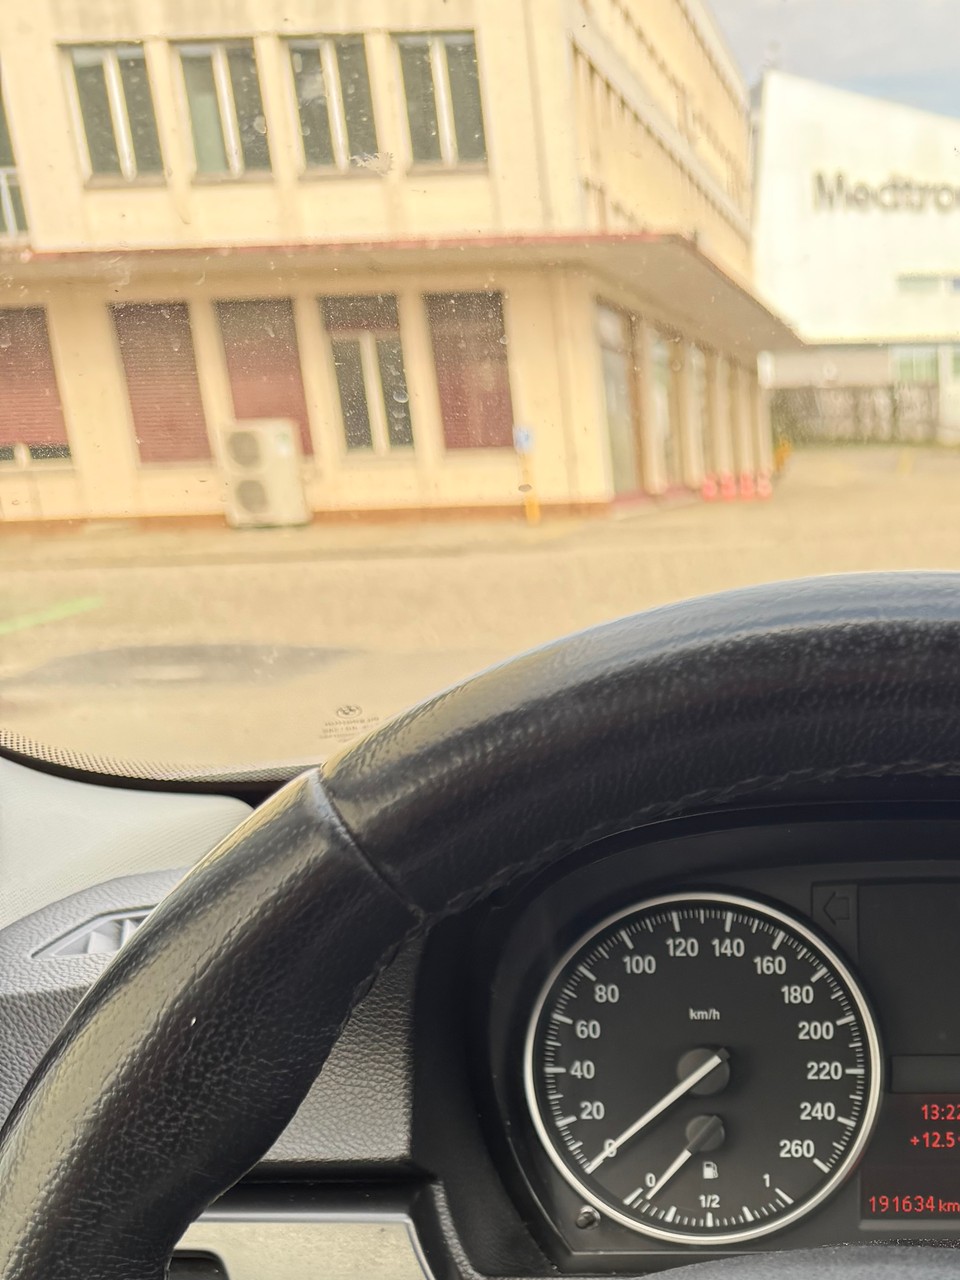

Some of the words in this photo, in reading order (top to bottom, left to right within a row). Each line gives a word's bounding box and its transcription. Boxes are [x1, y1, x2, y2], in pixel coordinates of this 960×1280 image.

[666, 938, 699, 957] 120
[712, 938, 745, 957] 140
[623, 956, 656, 974] 100
[753, 957, 786, 975] 160
[595, 985, 619, 1003] 80
[781, 986, 813, 1004] 180
[689, 1008, 720, 1020] km/h
[576, 1021, 600, 1039] 60
[798, 1022, 833, 1040] 200
[571, 1061, 595, 1079] 40
[807, 1062, 842, 1080] 220
[580, 1102, 604, 1119] 20
[800, 1102, 835, 1120] 240
[780, 1140, 814, 1158] 260
[645, 1173, 656, 1187] 0
[763, 1173, 770, 1186] 1
[699, 1195, 720, 1208] 1/2
[869, 1195, 935, 1212] 191634
[938, 1199, 960, 1212] km
